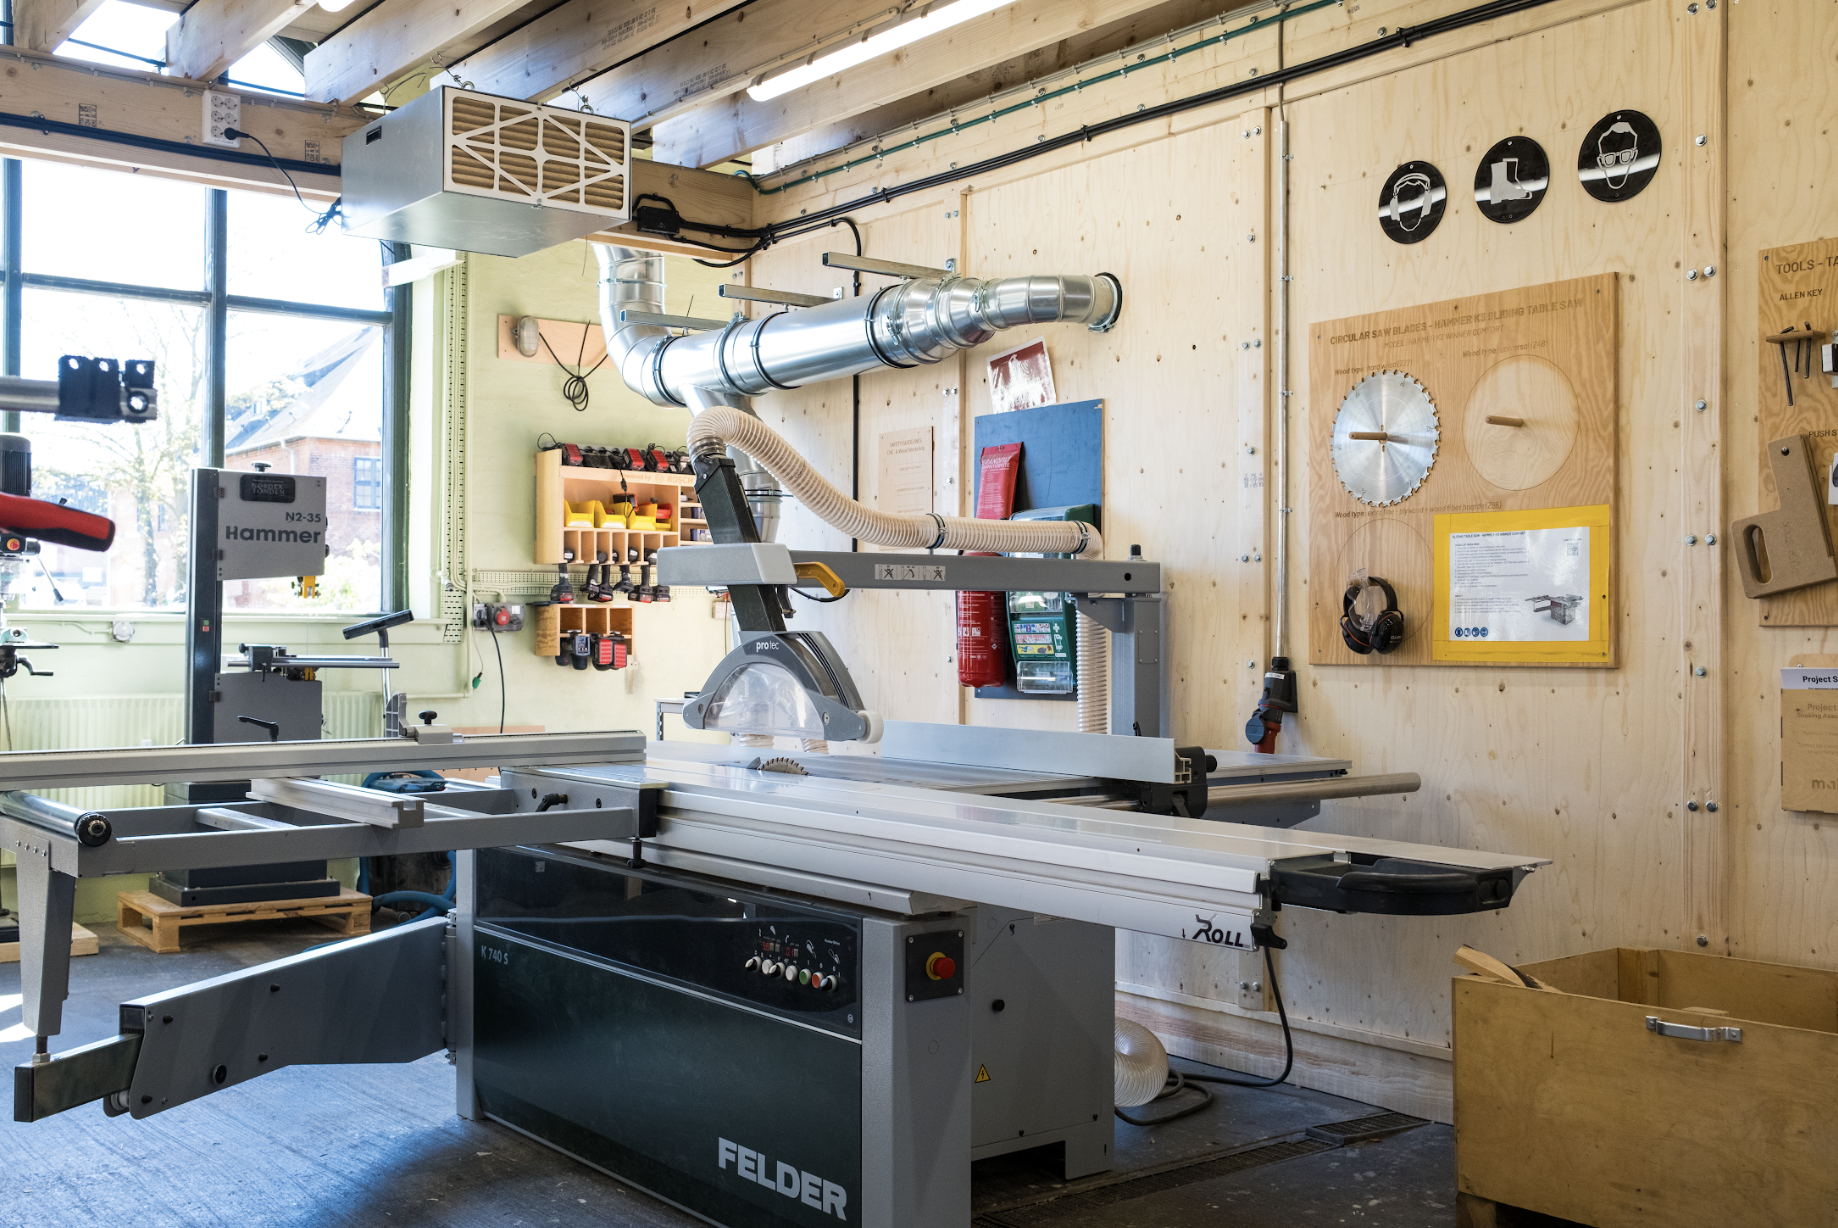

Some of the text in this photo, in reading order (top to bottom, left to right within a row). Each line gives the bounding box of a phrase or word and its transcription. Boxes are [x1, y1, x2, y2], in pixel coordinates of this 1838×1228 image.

[1775, 259, 1815, 275] TOOLS
[1779, 288, 1823, 301] ALLEN KEY
[1329, 330, 1370, 345] CIRCULAR
[1371, 327, 1392, 339] SAW
[1392, 321, 1427, 336] BLADES
[1434, 314, 1472, 329] HAMMER
[1487, 306, 1525, 321] SLIDING
[1526, 301, 1559, 316] TABLE
[1559, 297, 1584, 310] SAW
[1808, 429, 1838, 438] PUSH S
[667, 475, 693, 484] BOSCH
[285, 511, 321, 523] N2-35
[225, 525, 321, 544] Hammer
[1802, 675, 1832, 685] Project
[1807, 703, 1836, 713] Project
[481, 944, 509, 965] K 740 S
[718, 1136, 848, 1222] FELDER
